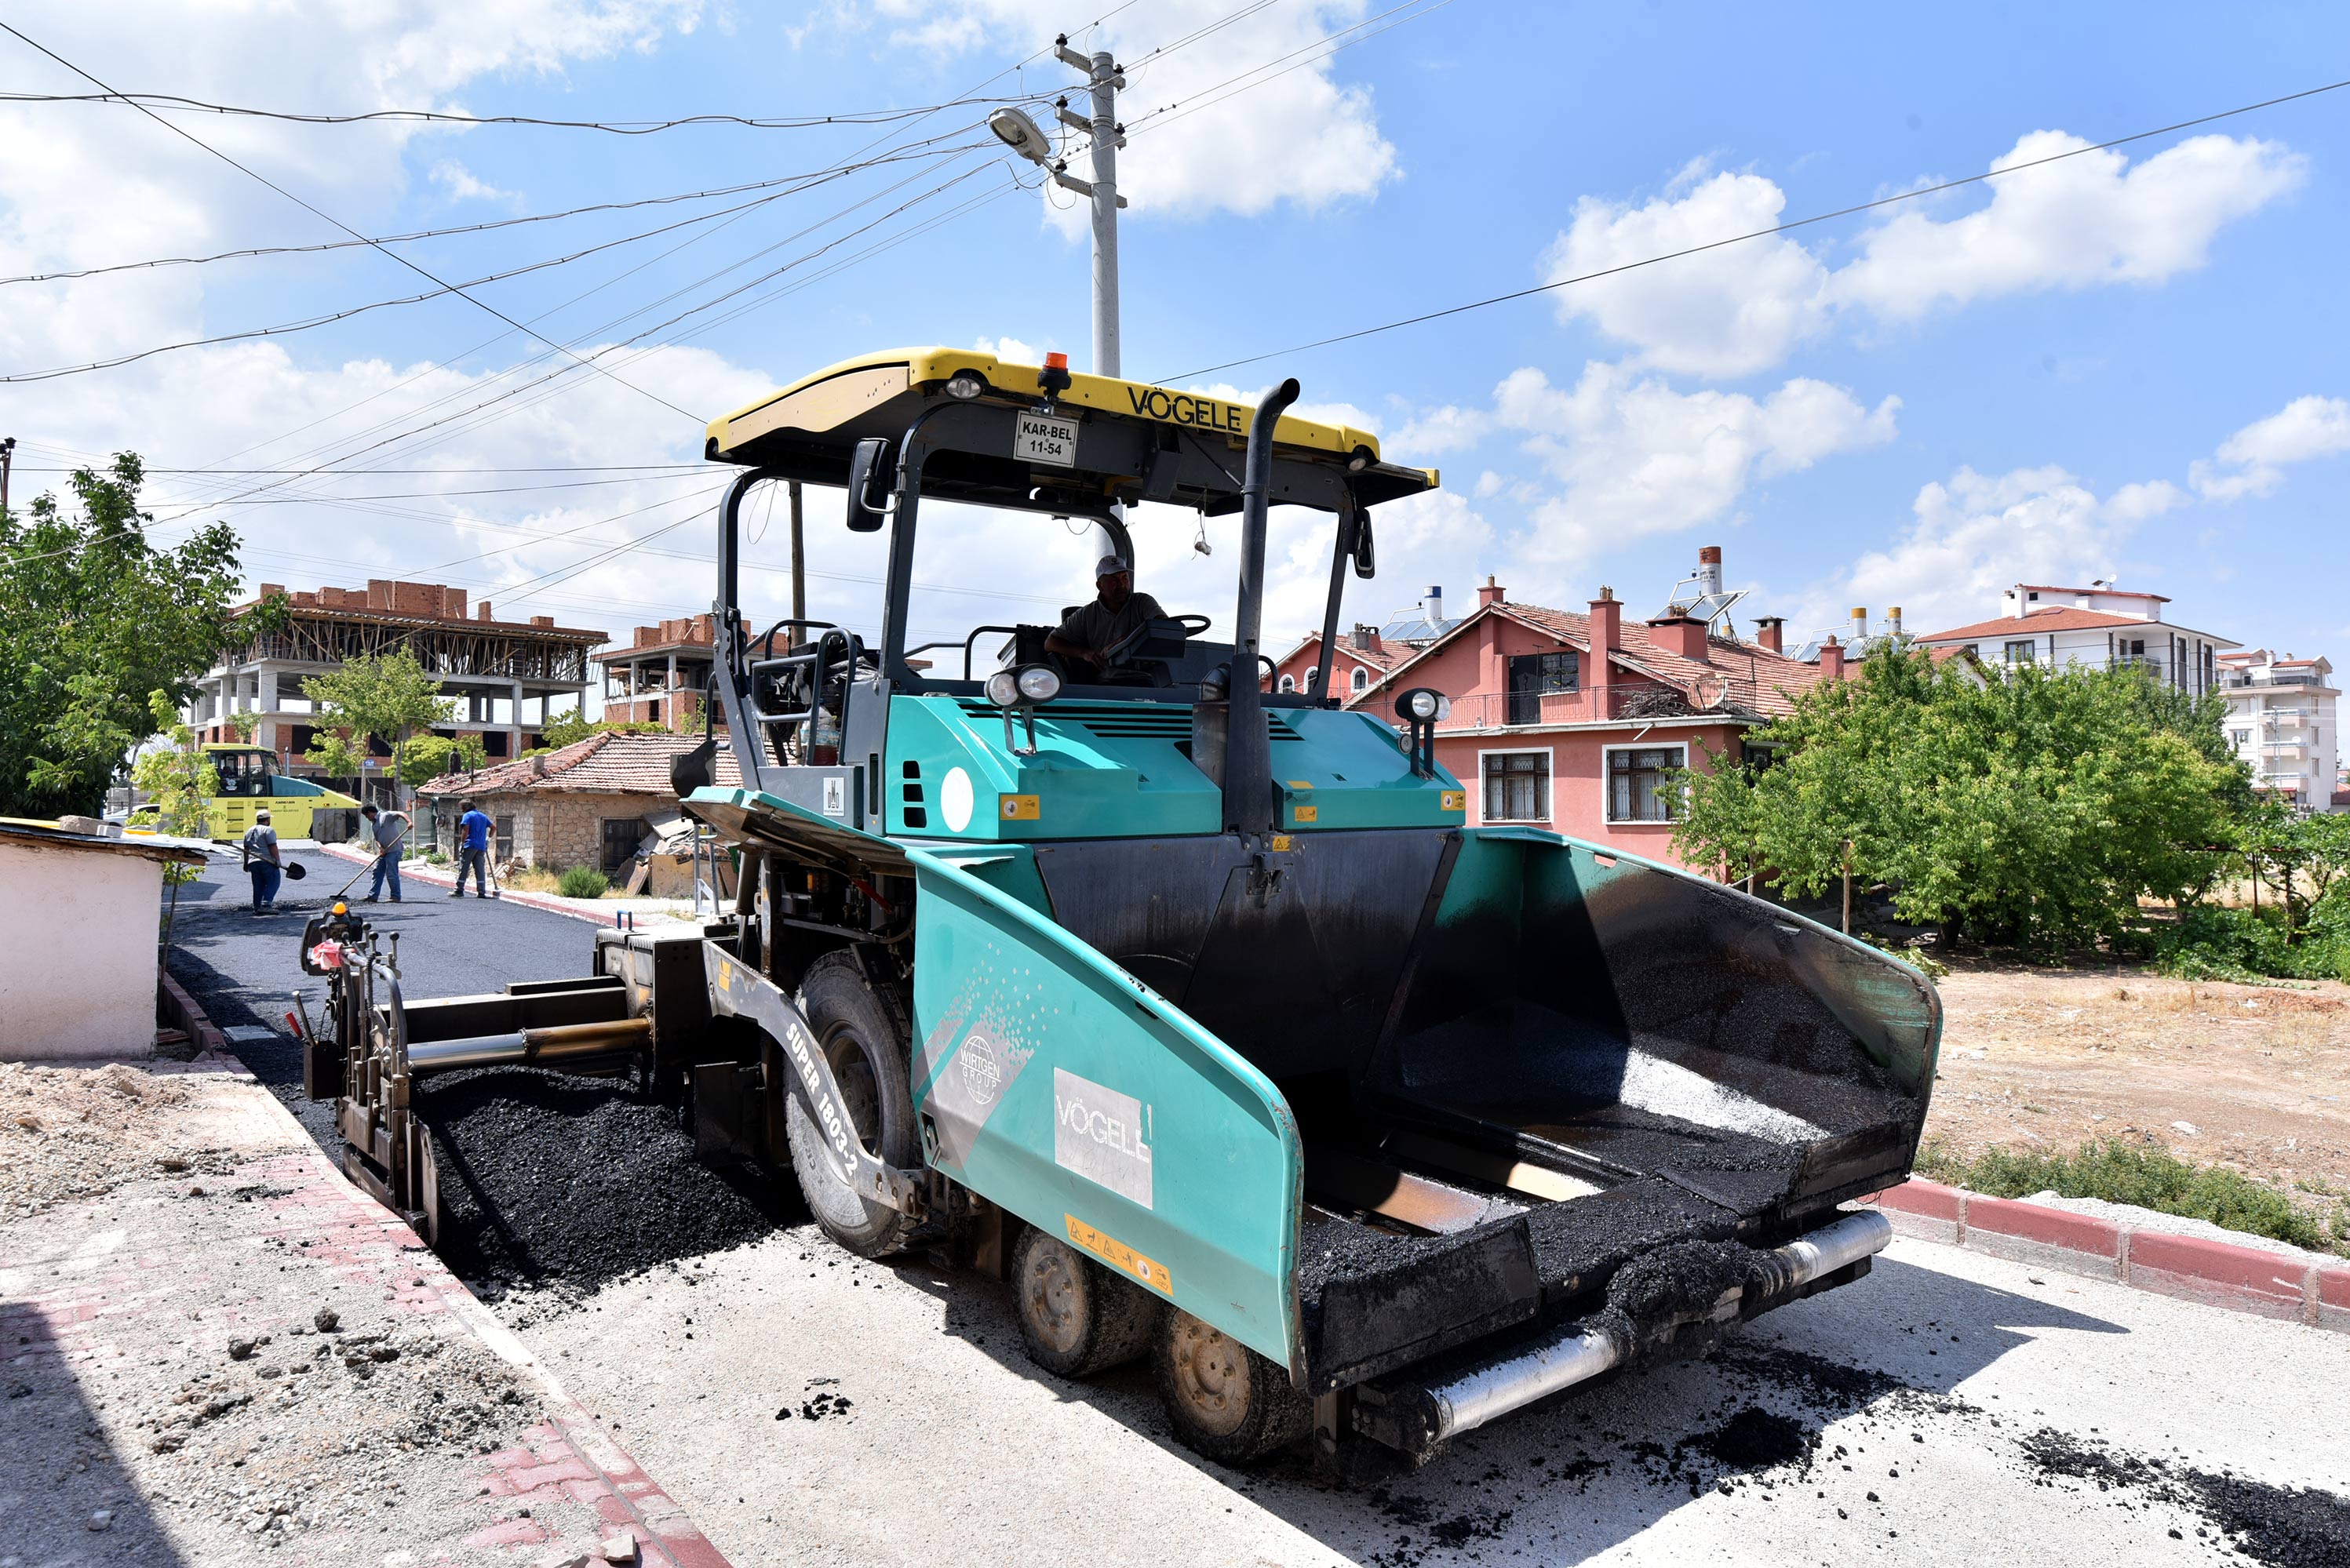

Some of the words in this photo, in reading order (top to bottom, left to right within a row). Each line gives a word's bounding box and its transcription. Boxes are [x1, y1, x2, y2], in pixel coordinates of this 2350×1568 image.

[1127, 387, 1241, 432] VÖGELE
[1022, 421, 1072, 440] KAR-BEL
[1030, 440, 1062, 456] 11-54
[960, 1048, 1000, 1079] WIRTGEN
[962, 1066, 997, 1090] GROUP
[786, 1022, 821, 1094] SUPER
[818, 1092, 858, 1177] 1803-2
